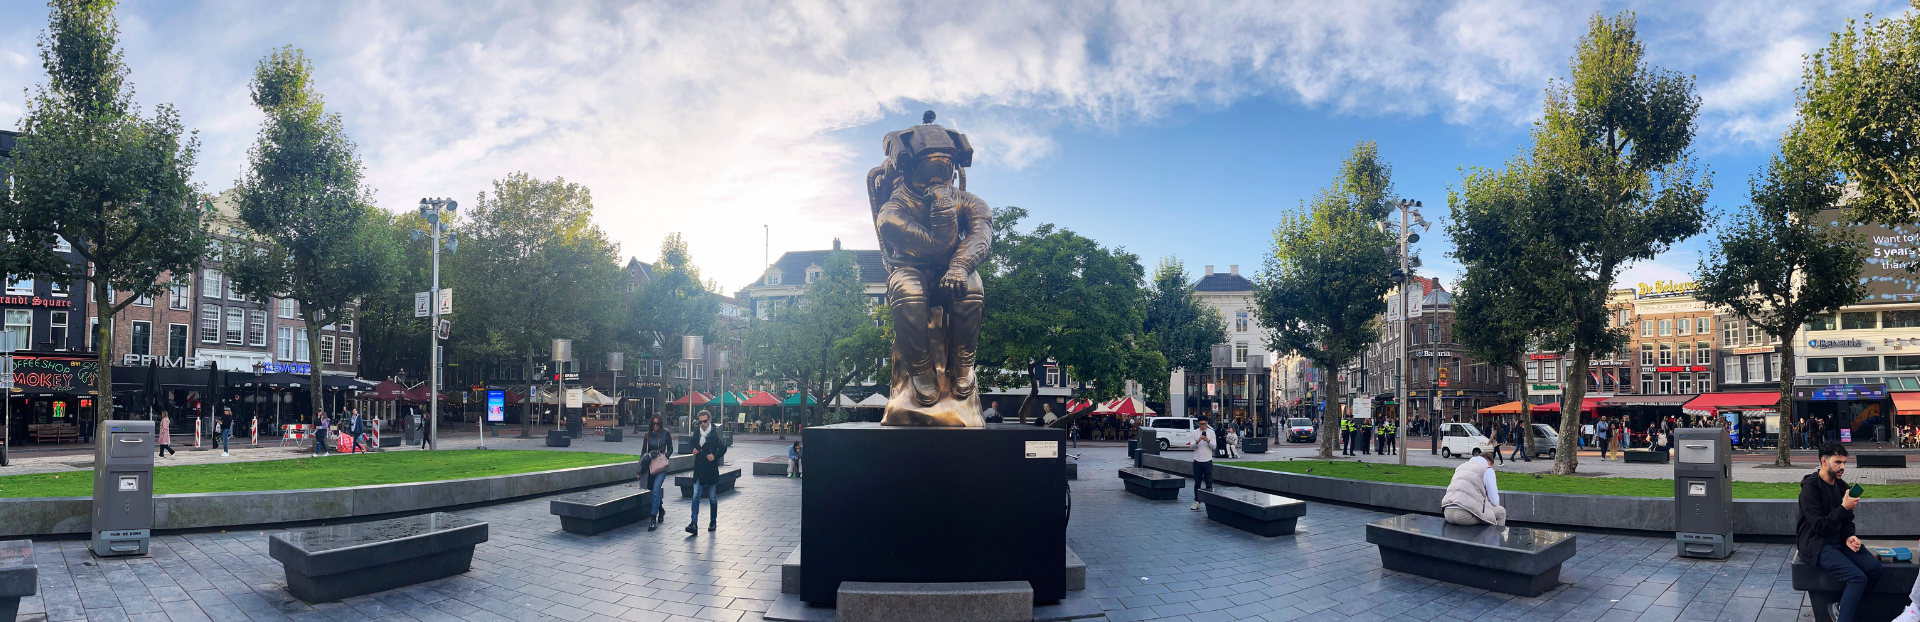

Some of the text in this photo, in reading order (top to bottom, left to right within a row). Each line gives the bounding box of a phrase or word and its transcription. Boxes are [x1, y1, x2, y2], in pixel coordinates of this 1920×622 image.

[1873, 235, 1901, 244] Want
[1903, 234, 1914, 242] to
[1874, 248, 1881, 257] 5
[1883, 248, 1915, 258] years
[1638, 282, 1653, 295] De
[32, 296, 72, 307] Square
[12, 359, 71, 374] OFFEESHOP
[123, 353, 200, 369] PRIME
[12, 372, 73, 387] MOKEY
